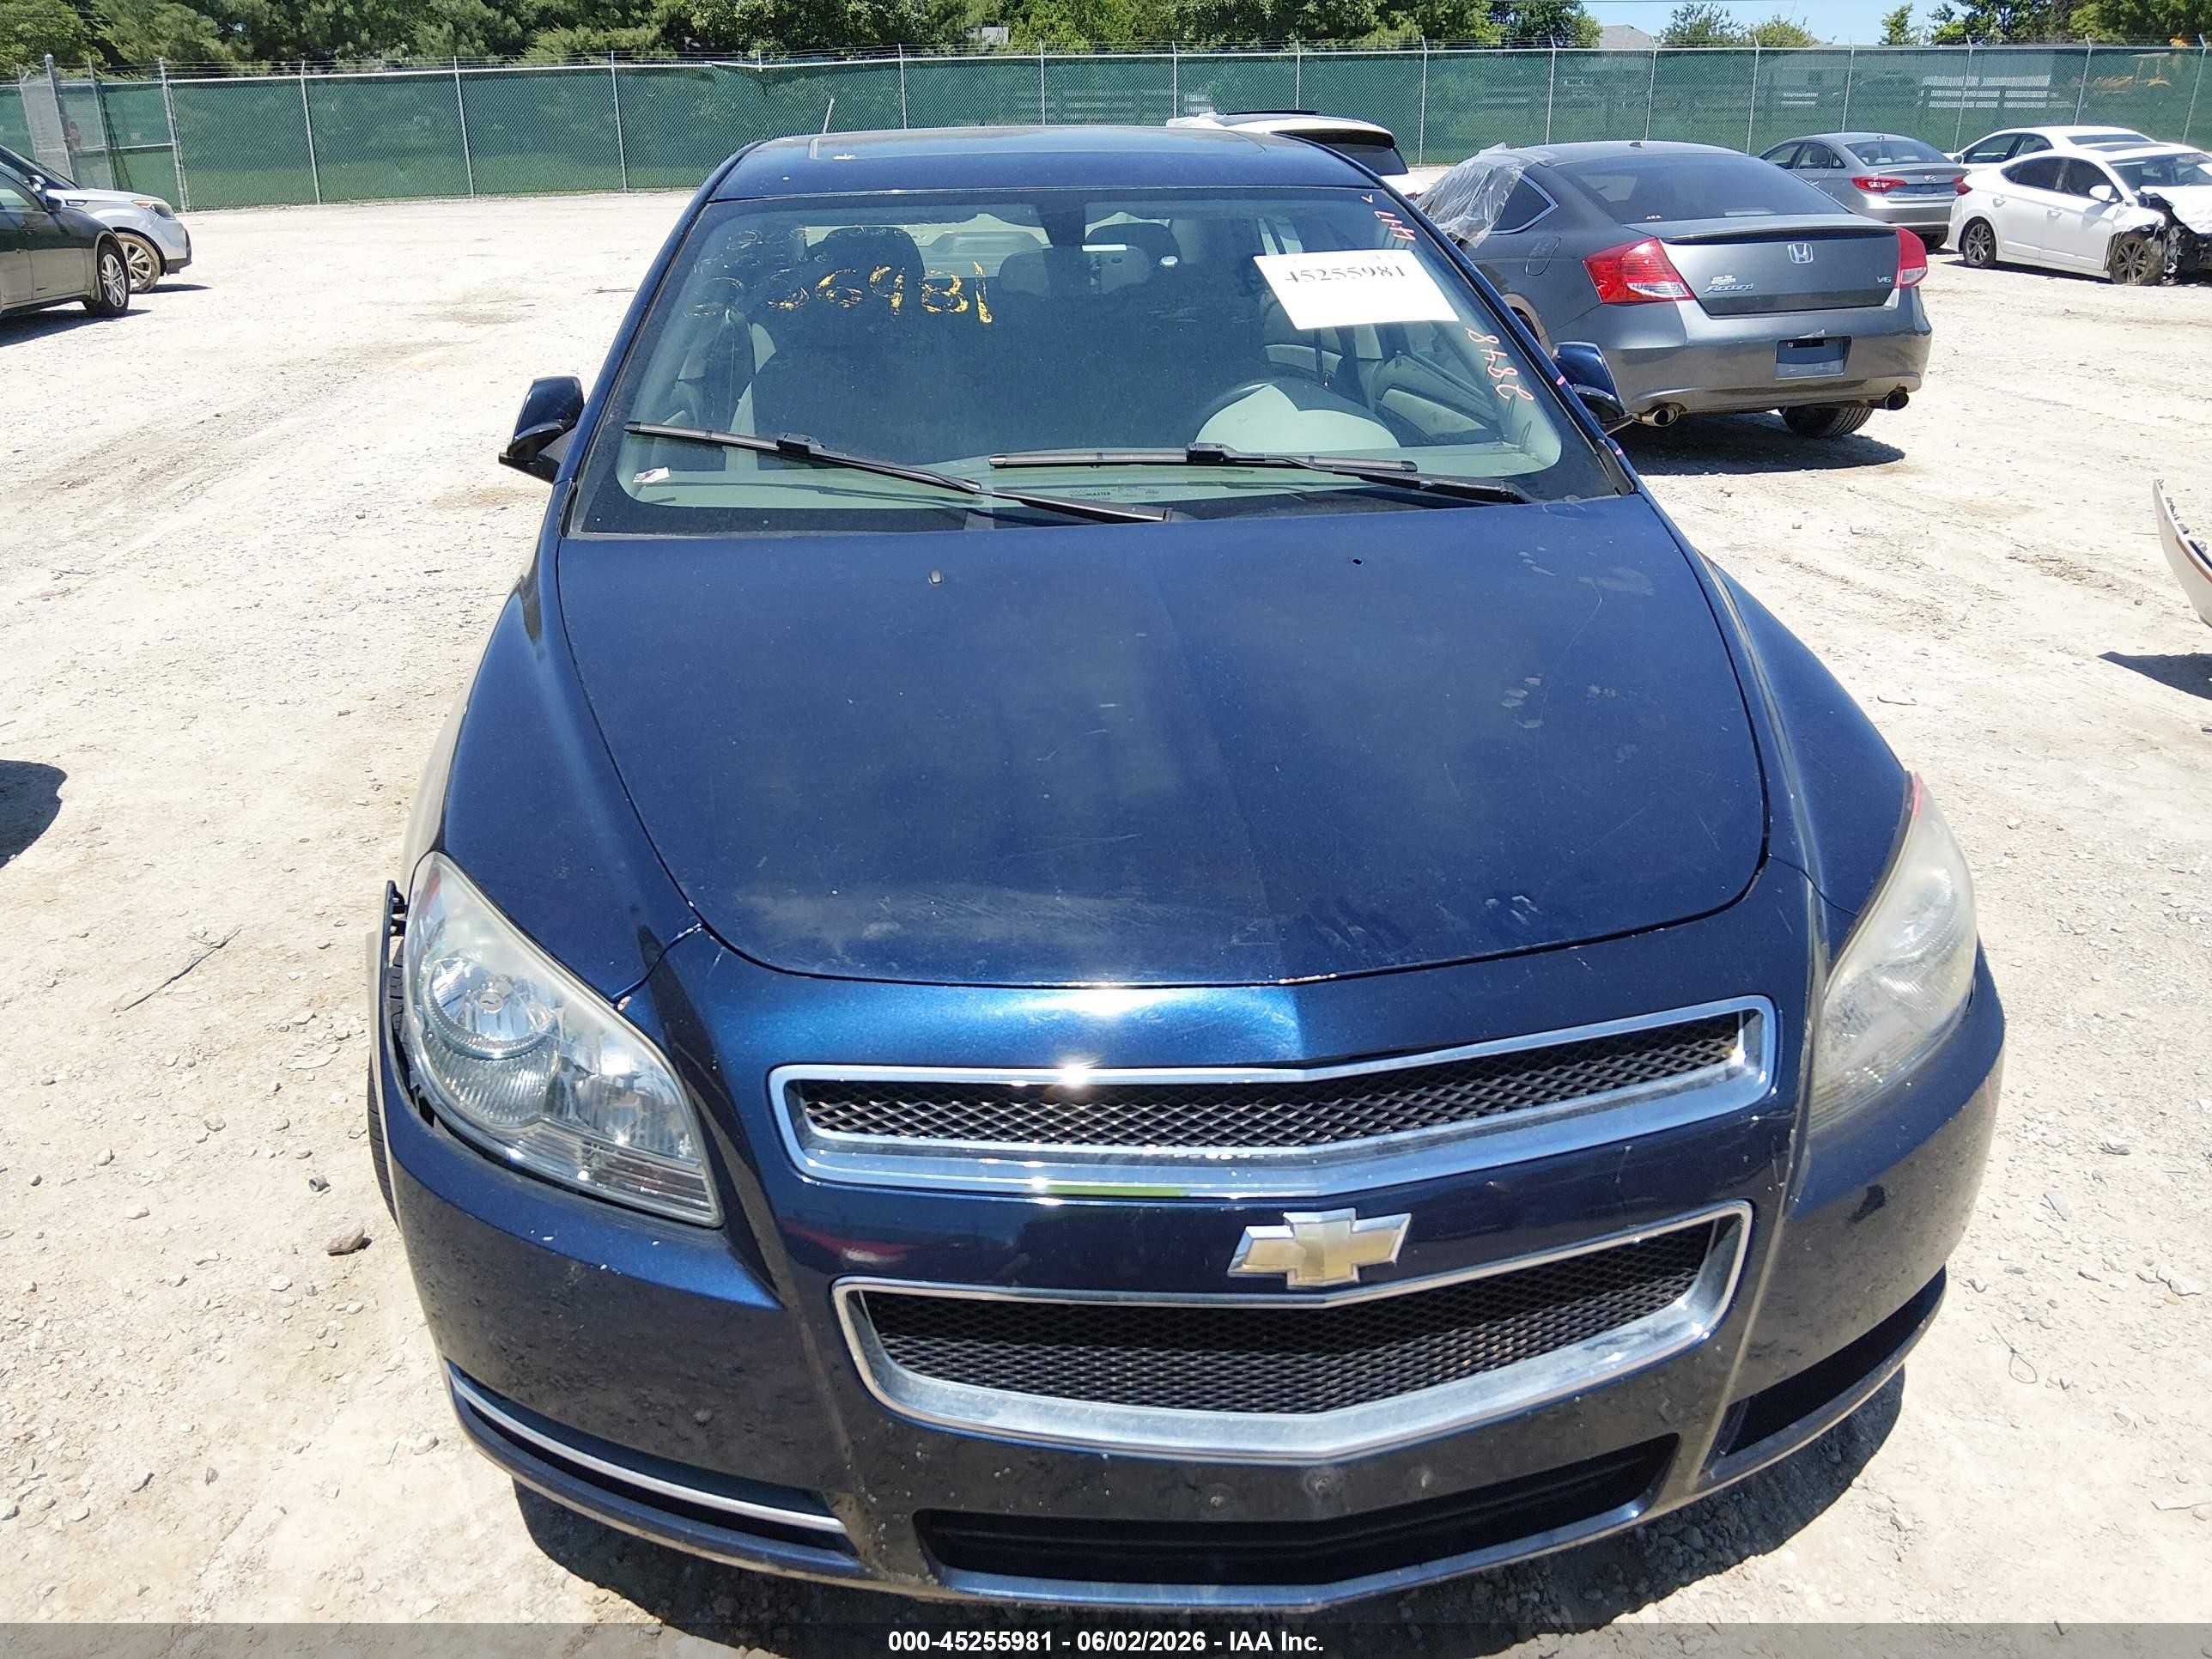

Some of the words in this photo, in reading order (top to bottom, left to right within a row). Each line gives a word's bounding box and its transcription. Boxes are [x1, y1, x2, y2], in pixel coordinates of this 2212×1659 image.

[1285, 265, 1406, 283] 45255981
[1704, 283, 1754, 294] Accord
[1464, 327, 1534, 401] 2848
